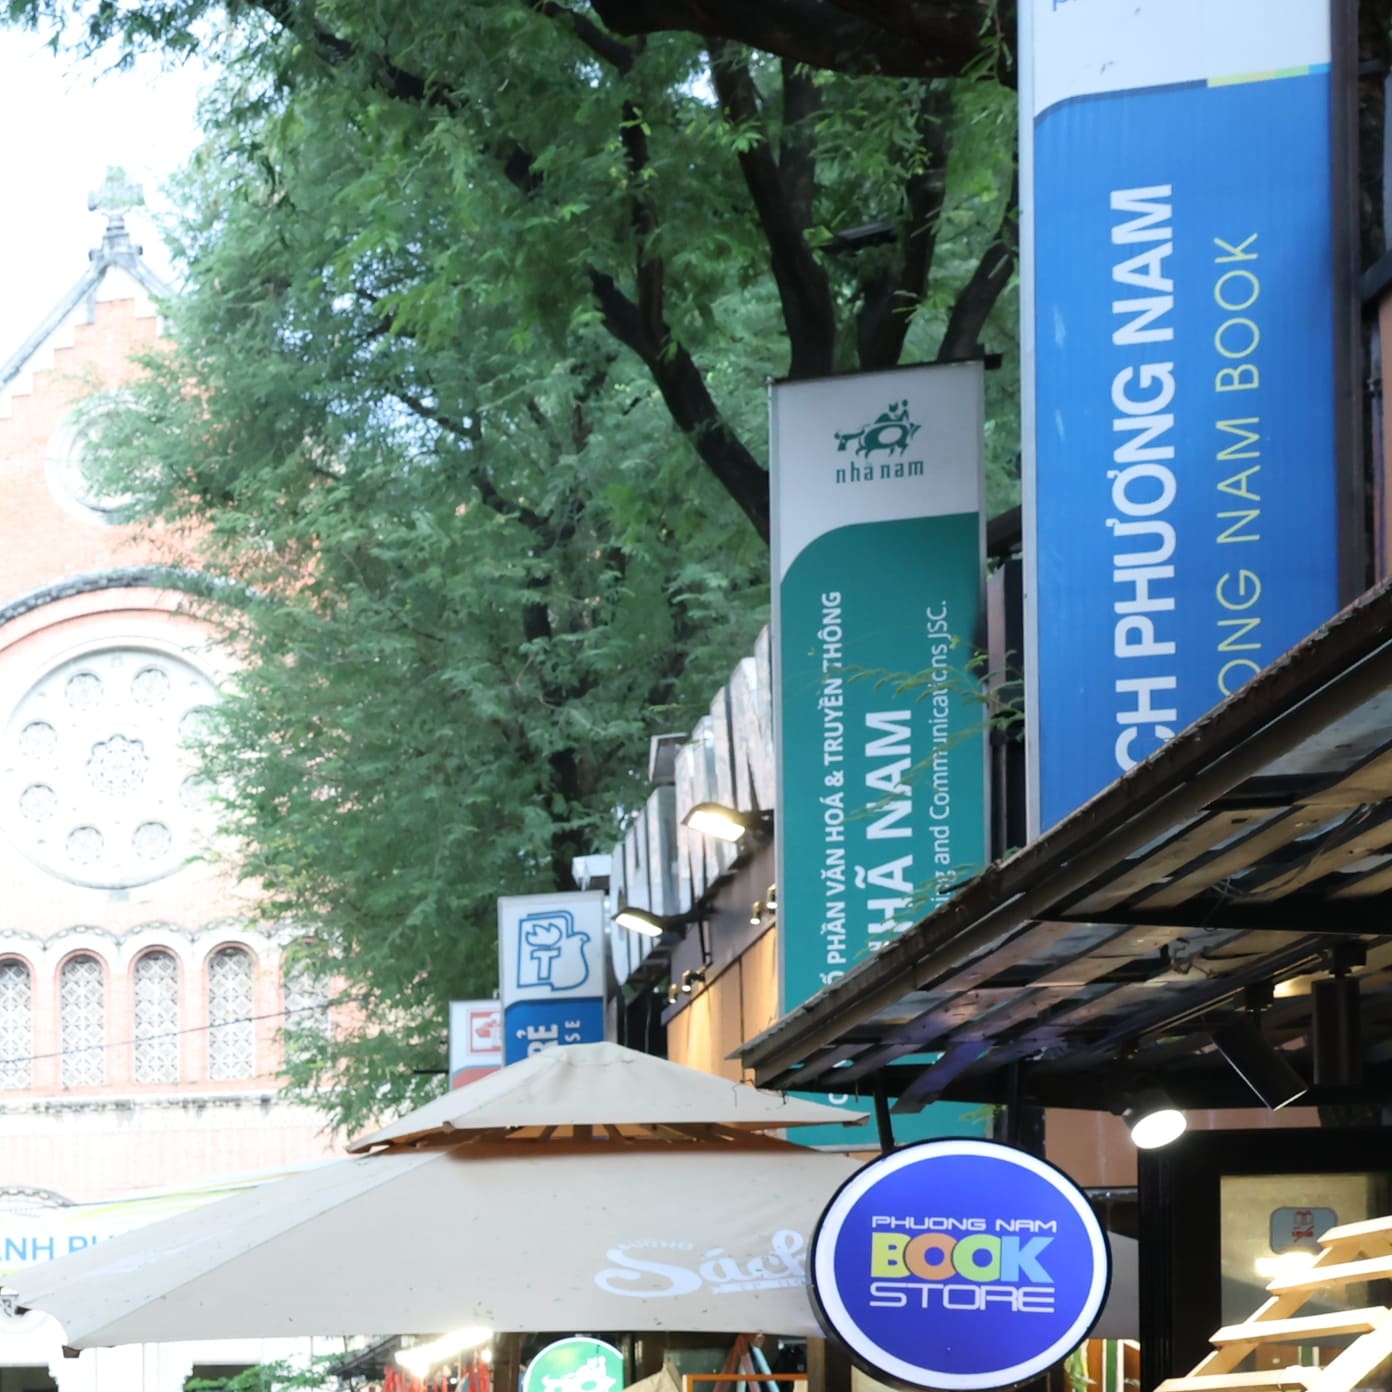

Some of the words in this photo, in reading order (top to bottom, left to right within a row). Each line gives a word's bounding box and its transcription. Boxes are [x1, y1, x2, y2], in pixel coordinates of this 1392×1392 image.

[1110, 184, 1174, 346] NAM
[1214, 233, 1260, 392] BOOK
[880, 460, 924, 480] nam
[1216, 417, 1261, 544] NAM
[1106, 361, 1177, 658] PHƯƠNG
[818, 591, 842, 672] THÔNG
[927, 600, 951, 639] JSC.
[824, 770, 844, 787] &
[865, 710, 912, 840] NAM
[820, 792, 845, 842] HOÁ
[932, 826, 950, 865] and
[821, 848, 845, 896] VĂN
[855, 854, 914, 951] HÃ
[820, 901, 847, 966] PHẦN
[871, 1215, 986, 1231] PHUONG
[995, 1218, 1057, 1232] NAM
[871, 1232, 1054, 1284] BOOK
[869, 1282, 1055, 1313] STORE
